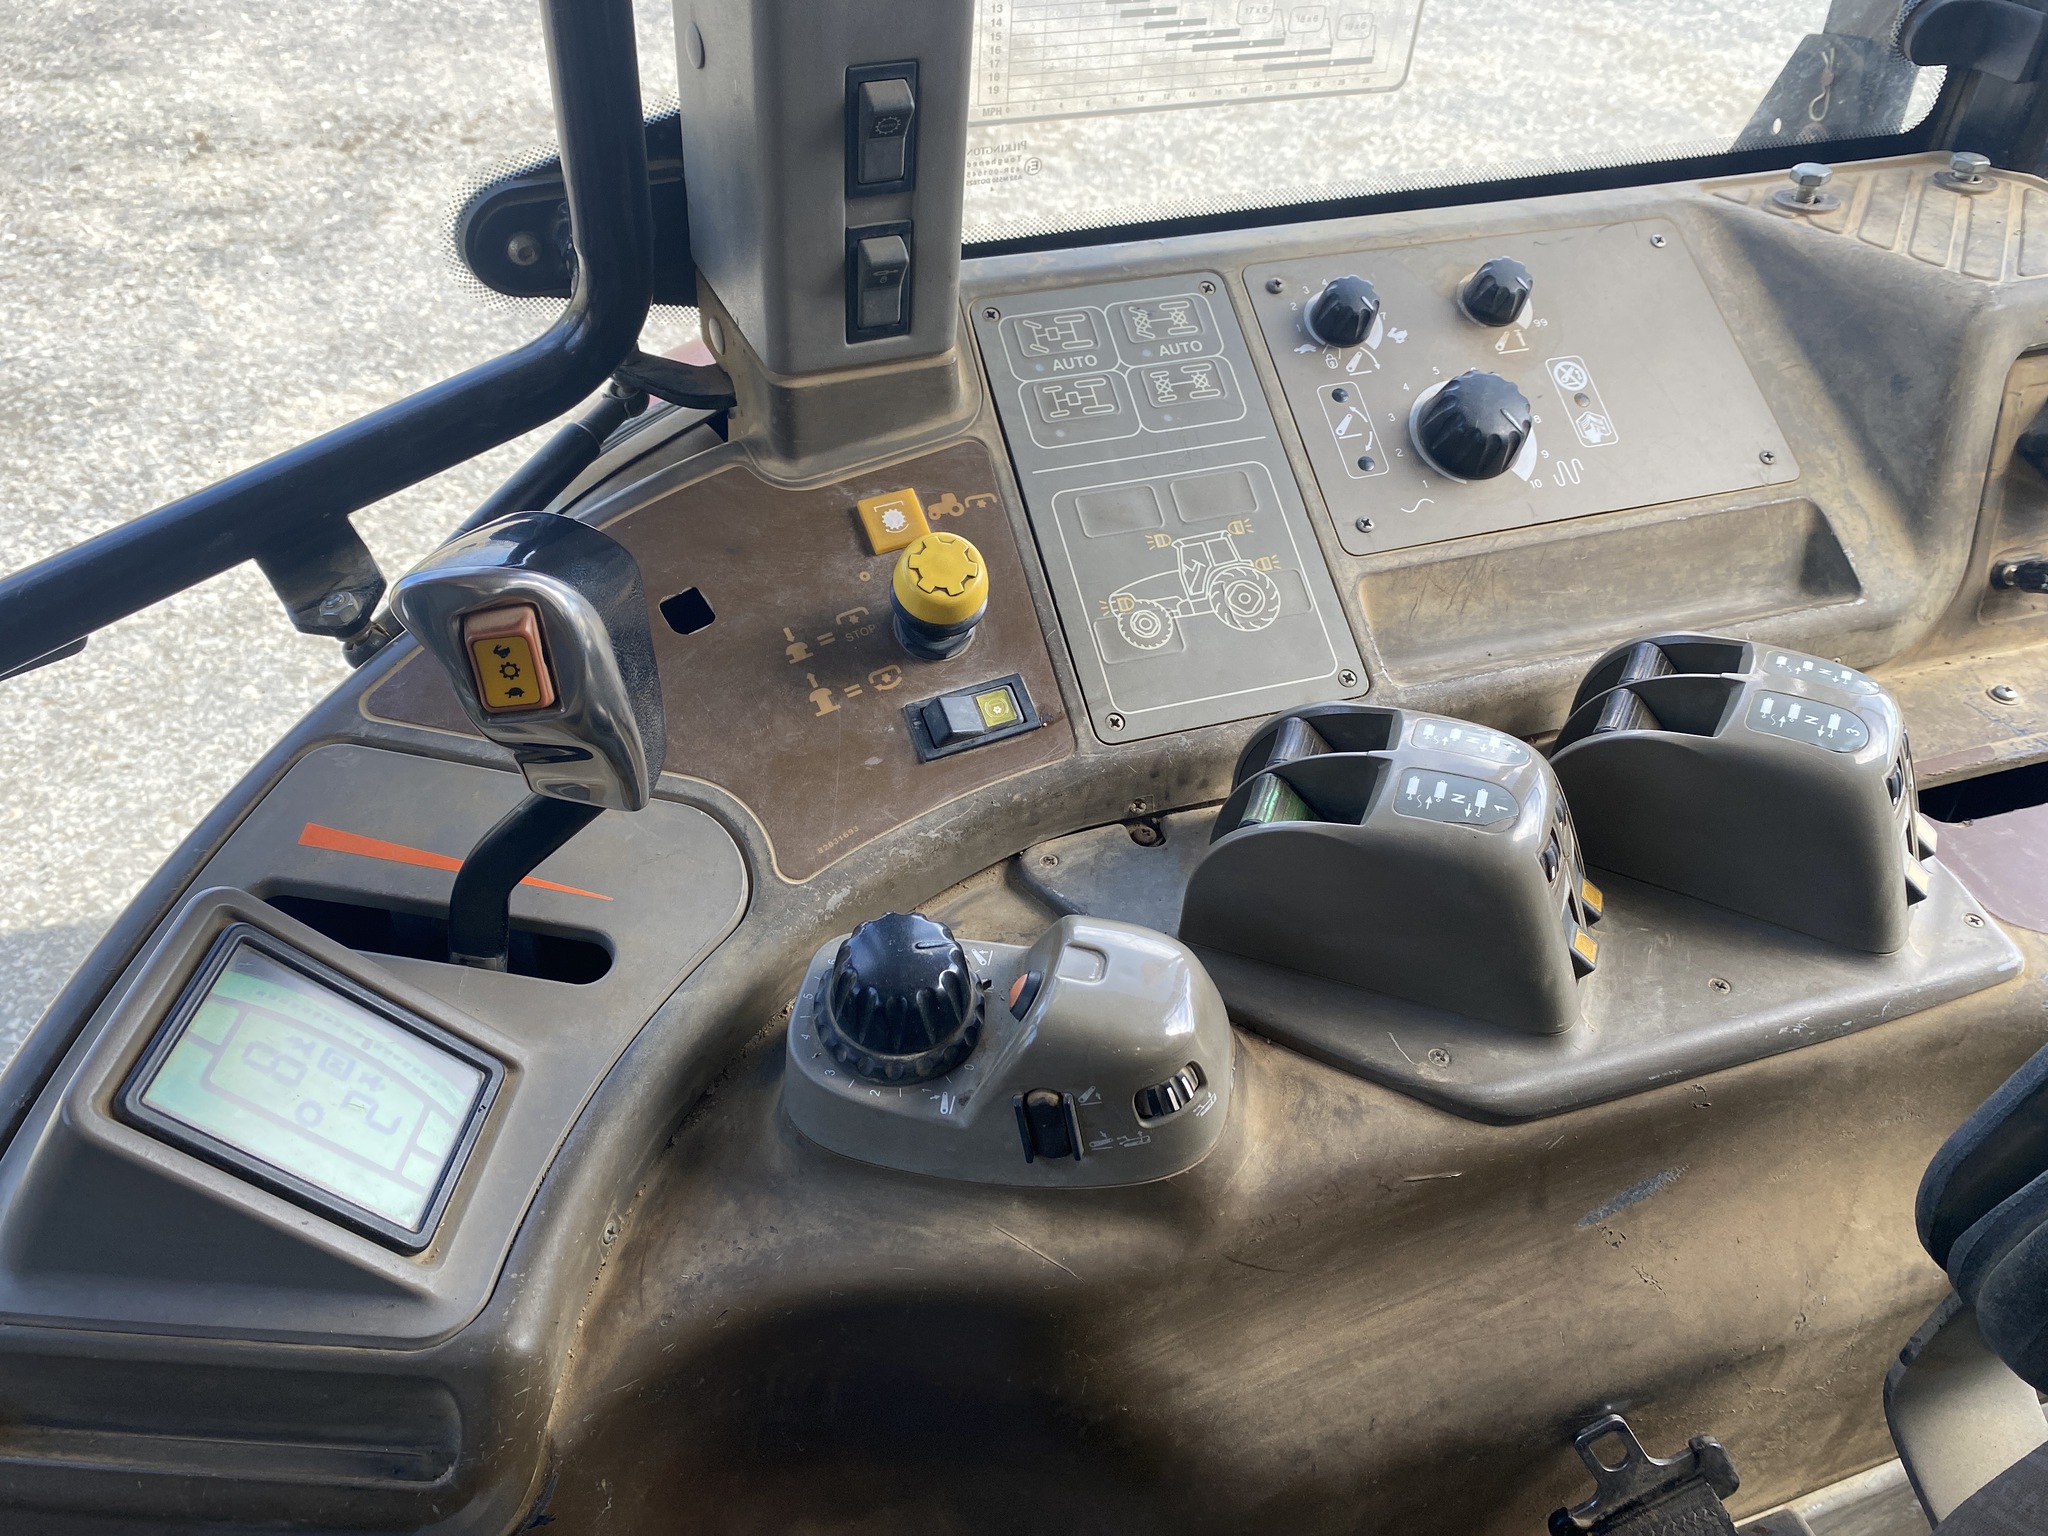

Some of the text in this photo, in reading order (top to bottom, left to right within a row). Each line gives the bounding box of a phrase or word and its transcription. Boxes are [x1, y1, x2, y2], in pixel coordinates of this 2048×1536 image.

[991, 4, 1003, 13] 13
[991, 18, 1002, 27] 14
[990, 32, 1001, 41] 15
[990, 45, 1001, 55] 16
[989, 59, 1000, 68] 17
[988, 73, 1000, 82] 18
[988, 85, 999, 95] 19
[982, 106, 1002, 117] MPH
[1302, 285, 1310, 295] 3
[1290, 302, 1298, 311] 2
[1379, 311, 1386, 321] 7
[1532, 318, 1548, 328] 99
[1160, 340, 1203, 357] AUTO
[1053, 354, 1098, 371] AUTO
[1432, 366, 1440, 375] 5
[1403, 382, 1410, 391] 4
[1388, 413, 1396, 422] 3
[1532, 415, 1542, 424] 8
[1395, 448, 1403, 457] 2
[1540, 449, 1549, 459] 9
[1530, 478, 1543, 489] 10
[845, 624, 876, 642] STOP
[1845, 727, 1860, 738] 3
[817, 825, 859, 854] 82031693
[803, 992, 814, 1000] 5
[801, 1033, 811, 1041] 4
[823, 1068, 836, 1077] 3
[869, 1088, 881, 1097] 2
